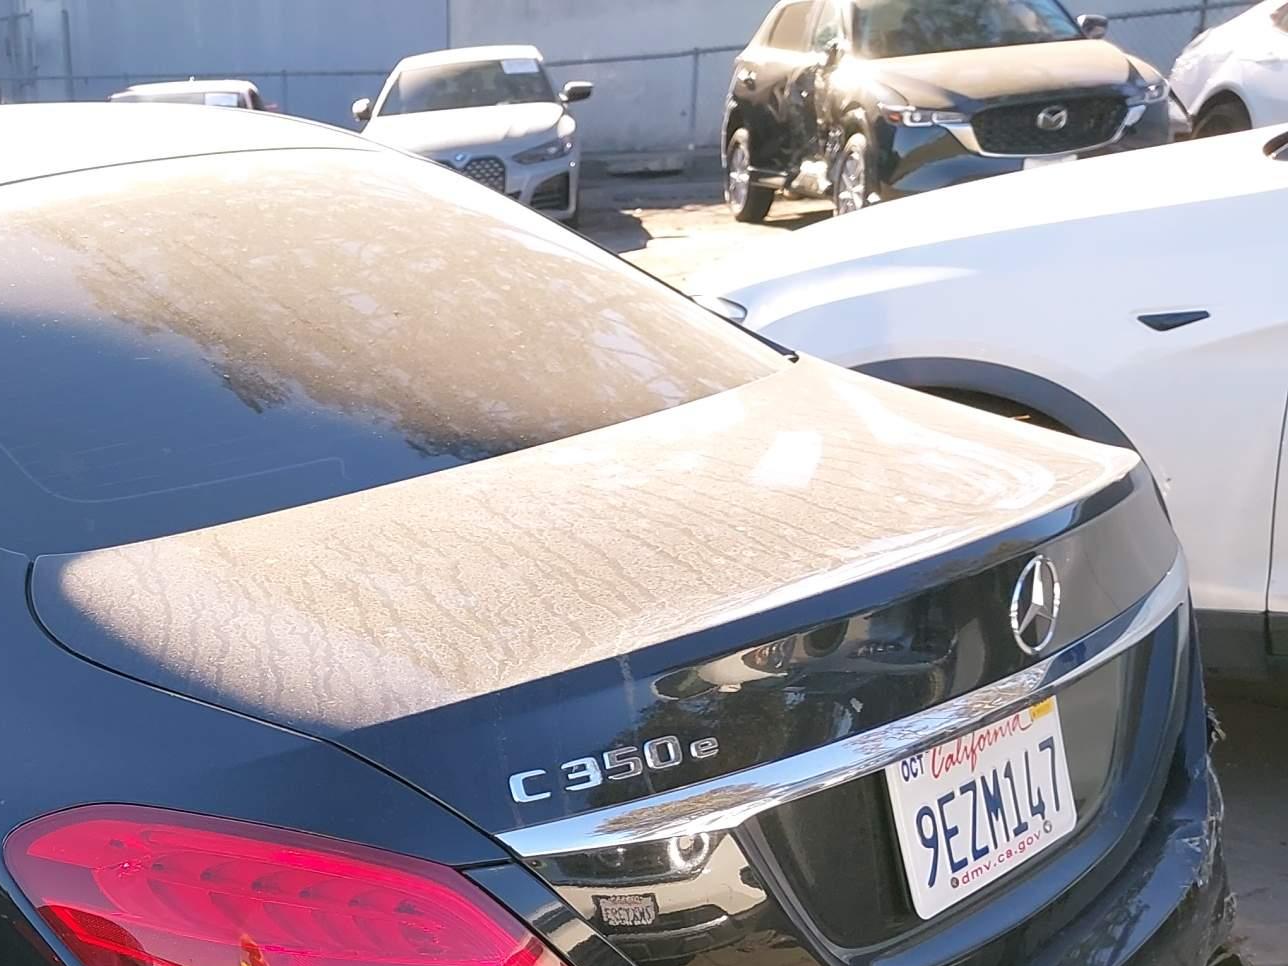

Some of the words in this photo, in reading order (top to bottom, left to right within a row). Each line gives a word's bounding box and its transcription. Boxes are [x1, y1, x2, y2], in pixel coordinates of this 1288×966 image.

[509, 768, 551, 803] C
[560, 735, 683, 791] 350
[689, 736, 719, 759] e
[901, 755, 925, 782] OCT
[930, 713, 1031, 779] California
[915, 736, 1060, 888] 9EZM147
[961, 830, 1041, 885] dmv.ca.gov
